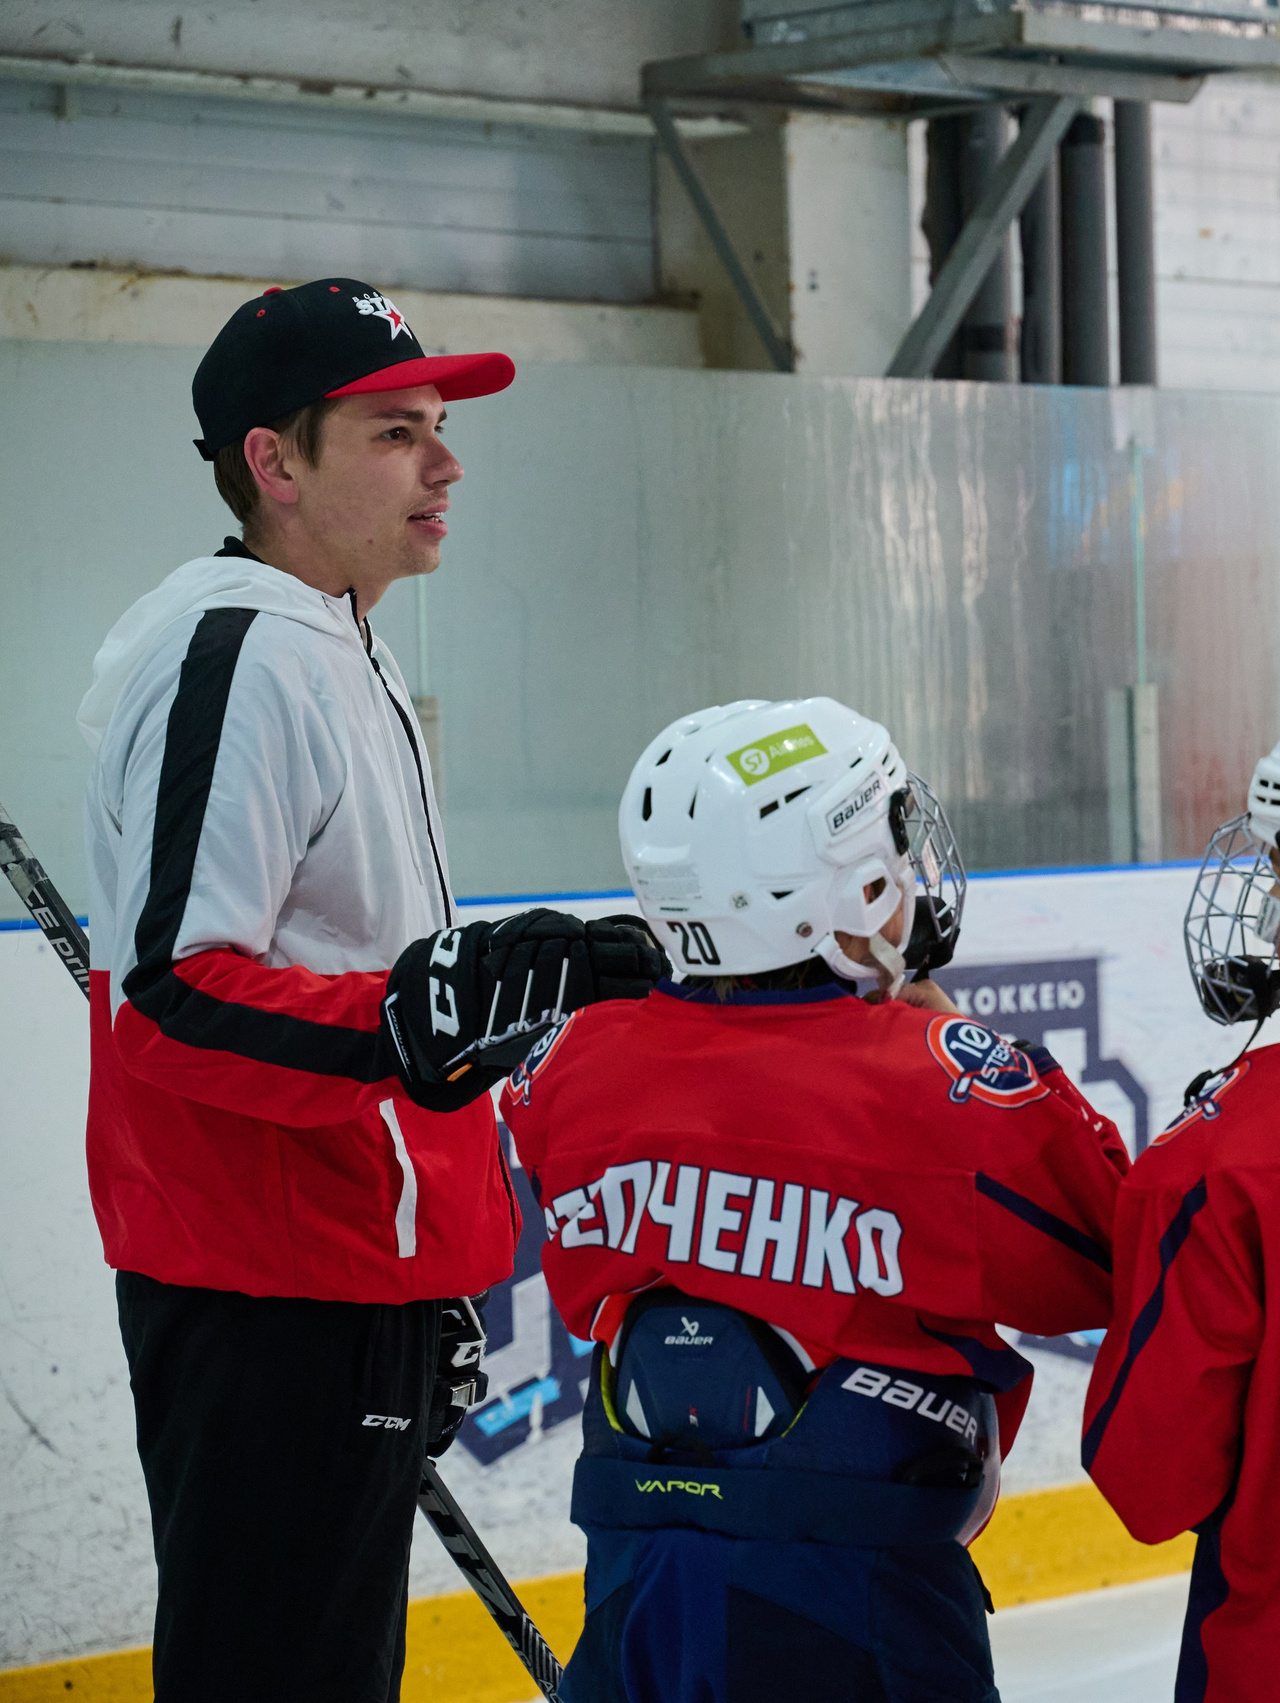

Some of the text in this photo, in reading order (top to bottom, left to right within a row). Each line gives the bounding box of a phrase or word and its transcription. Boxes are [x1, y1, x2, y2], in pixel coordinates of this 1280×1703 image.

[665, 921, 721, 966] 20
[954, 980, 1086, 1016] ХОККЕЮ
[361, 1414, 412, 1431] CCM
[635, 1478, 723, 1499] VAPOR
